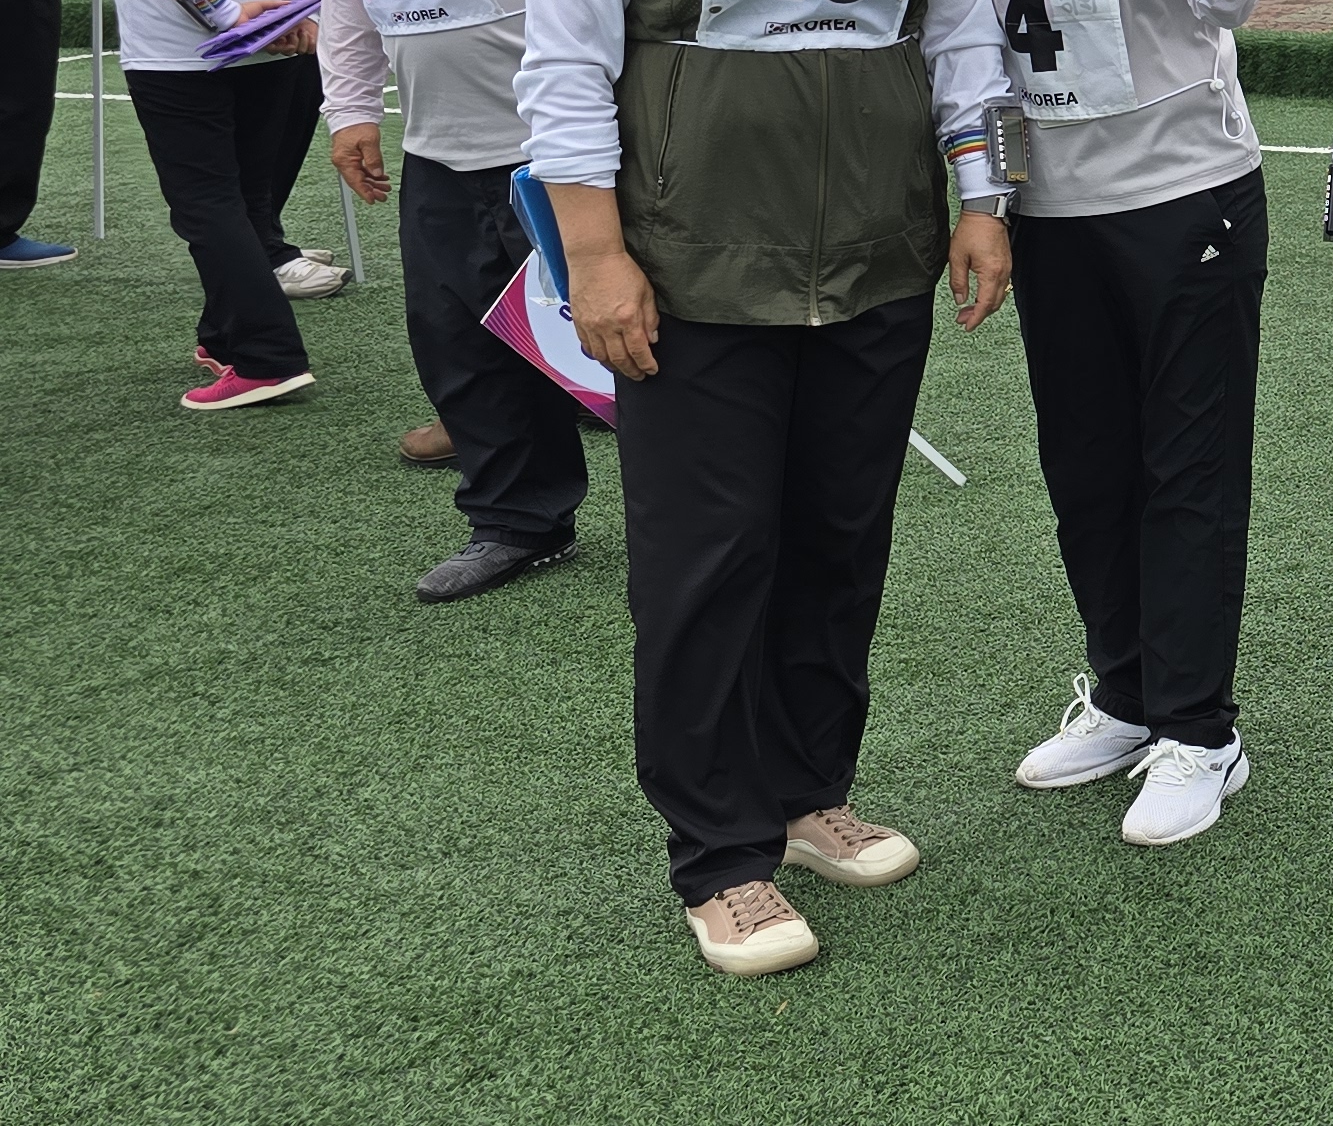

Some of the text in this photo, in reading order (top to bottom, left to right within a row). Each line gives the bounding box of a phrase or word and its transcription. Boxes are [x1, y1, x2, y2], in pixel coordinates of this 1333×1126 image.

[405, 7, 449, 23] KOREA
[789, 18, 857, 33] KOREA
[1029, 91, 1079, 107] KOREA
